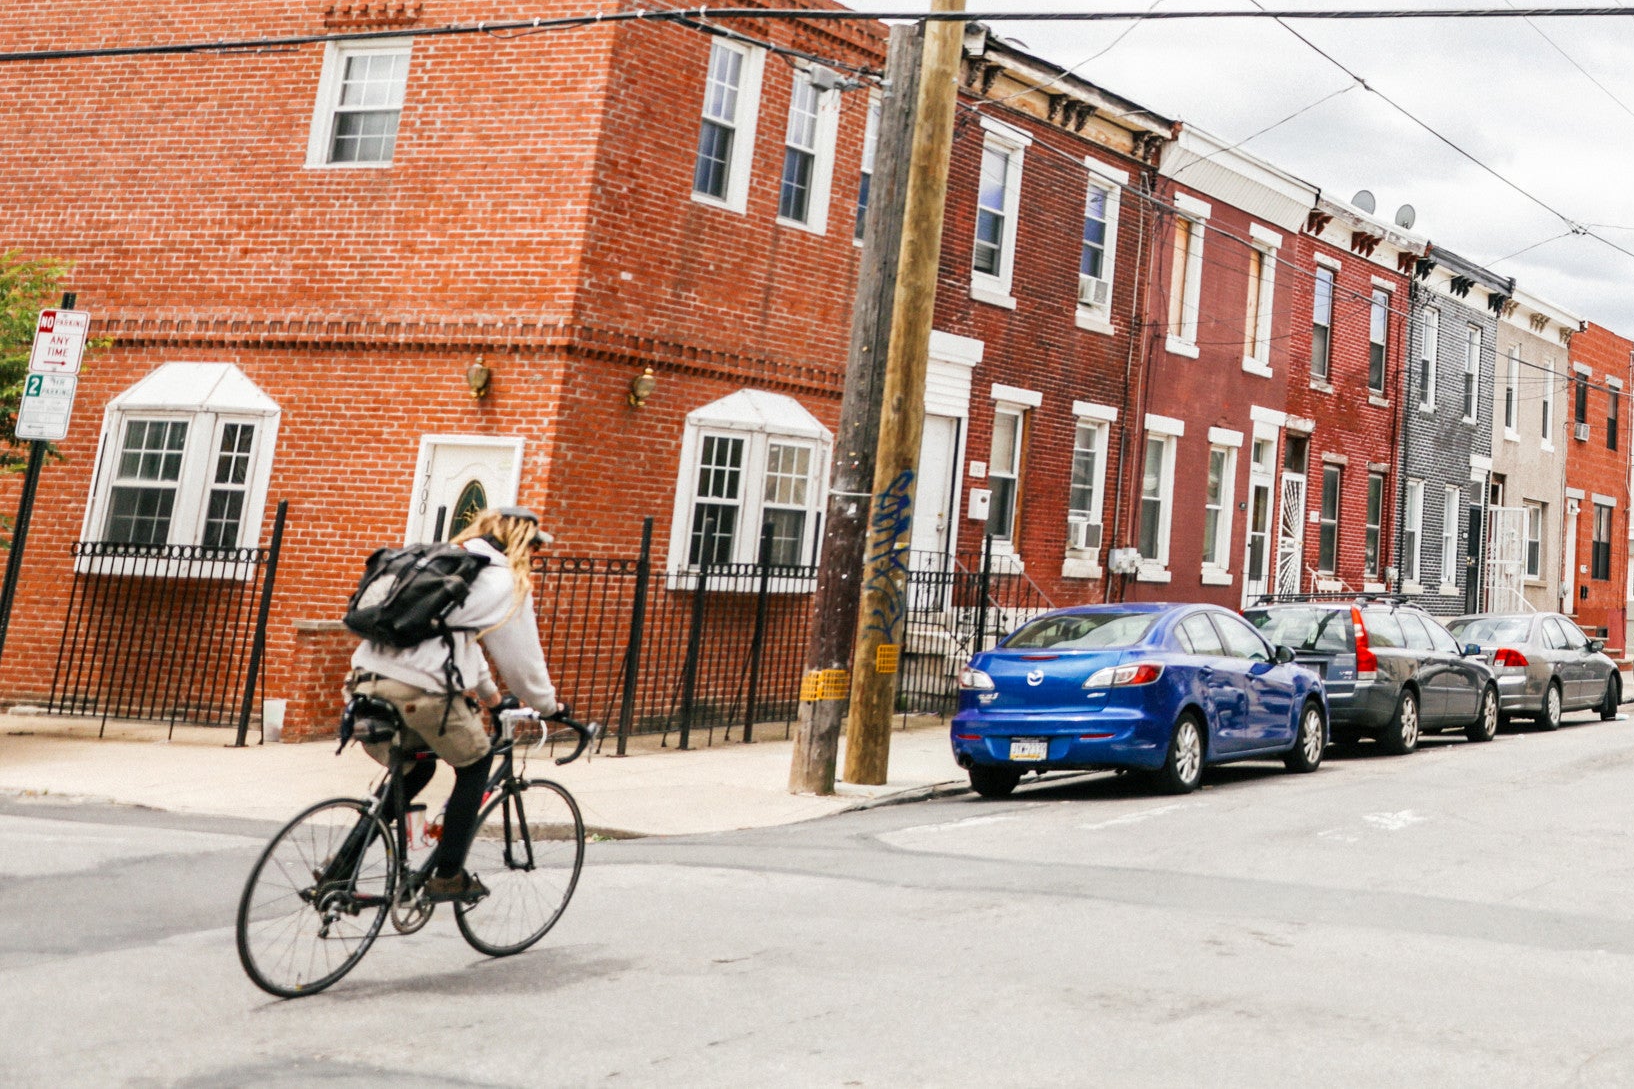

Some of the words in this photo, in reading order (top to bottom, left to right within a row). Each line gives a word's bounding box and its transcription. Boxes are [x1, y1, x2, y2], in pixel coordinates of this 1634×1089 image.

[41, 316, 55, 328] NO
[56, 318, 84, 328] PARKING
[50, 336, 70, 345] ANY
[47, 347, 68, 358] TIME
[28, 377, 41, 395] 2
[42, 387, 71, 396] PARKING
[419, 460, 432, 515] 1700
